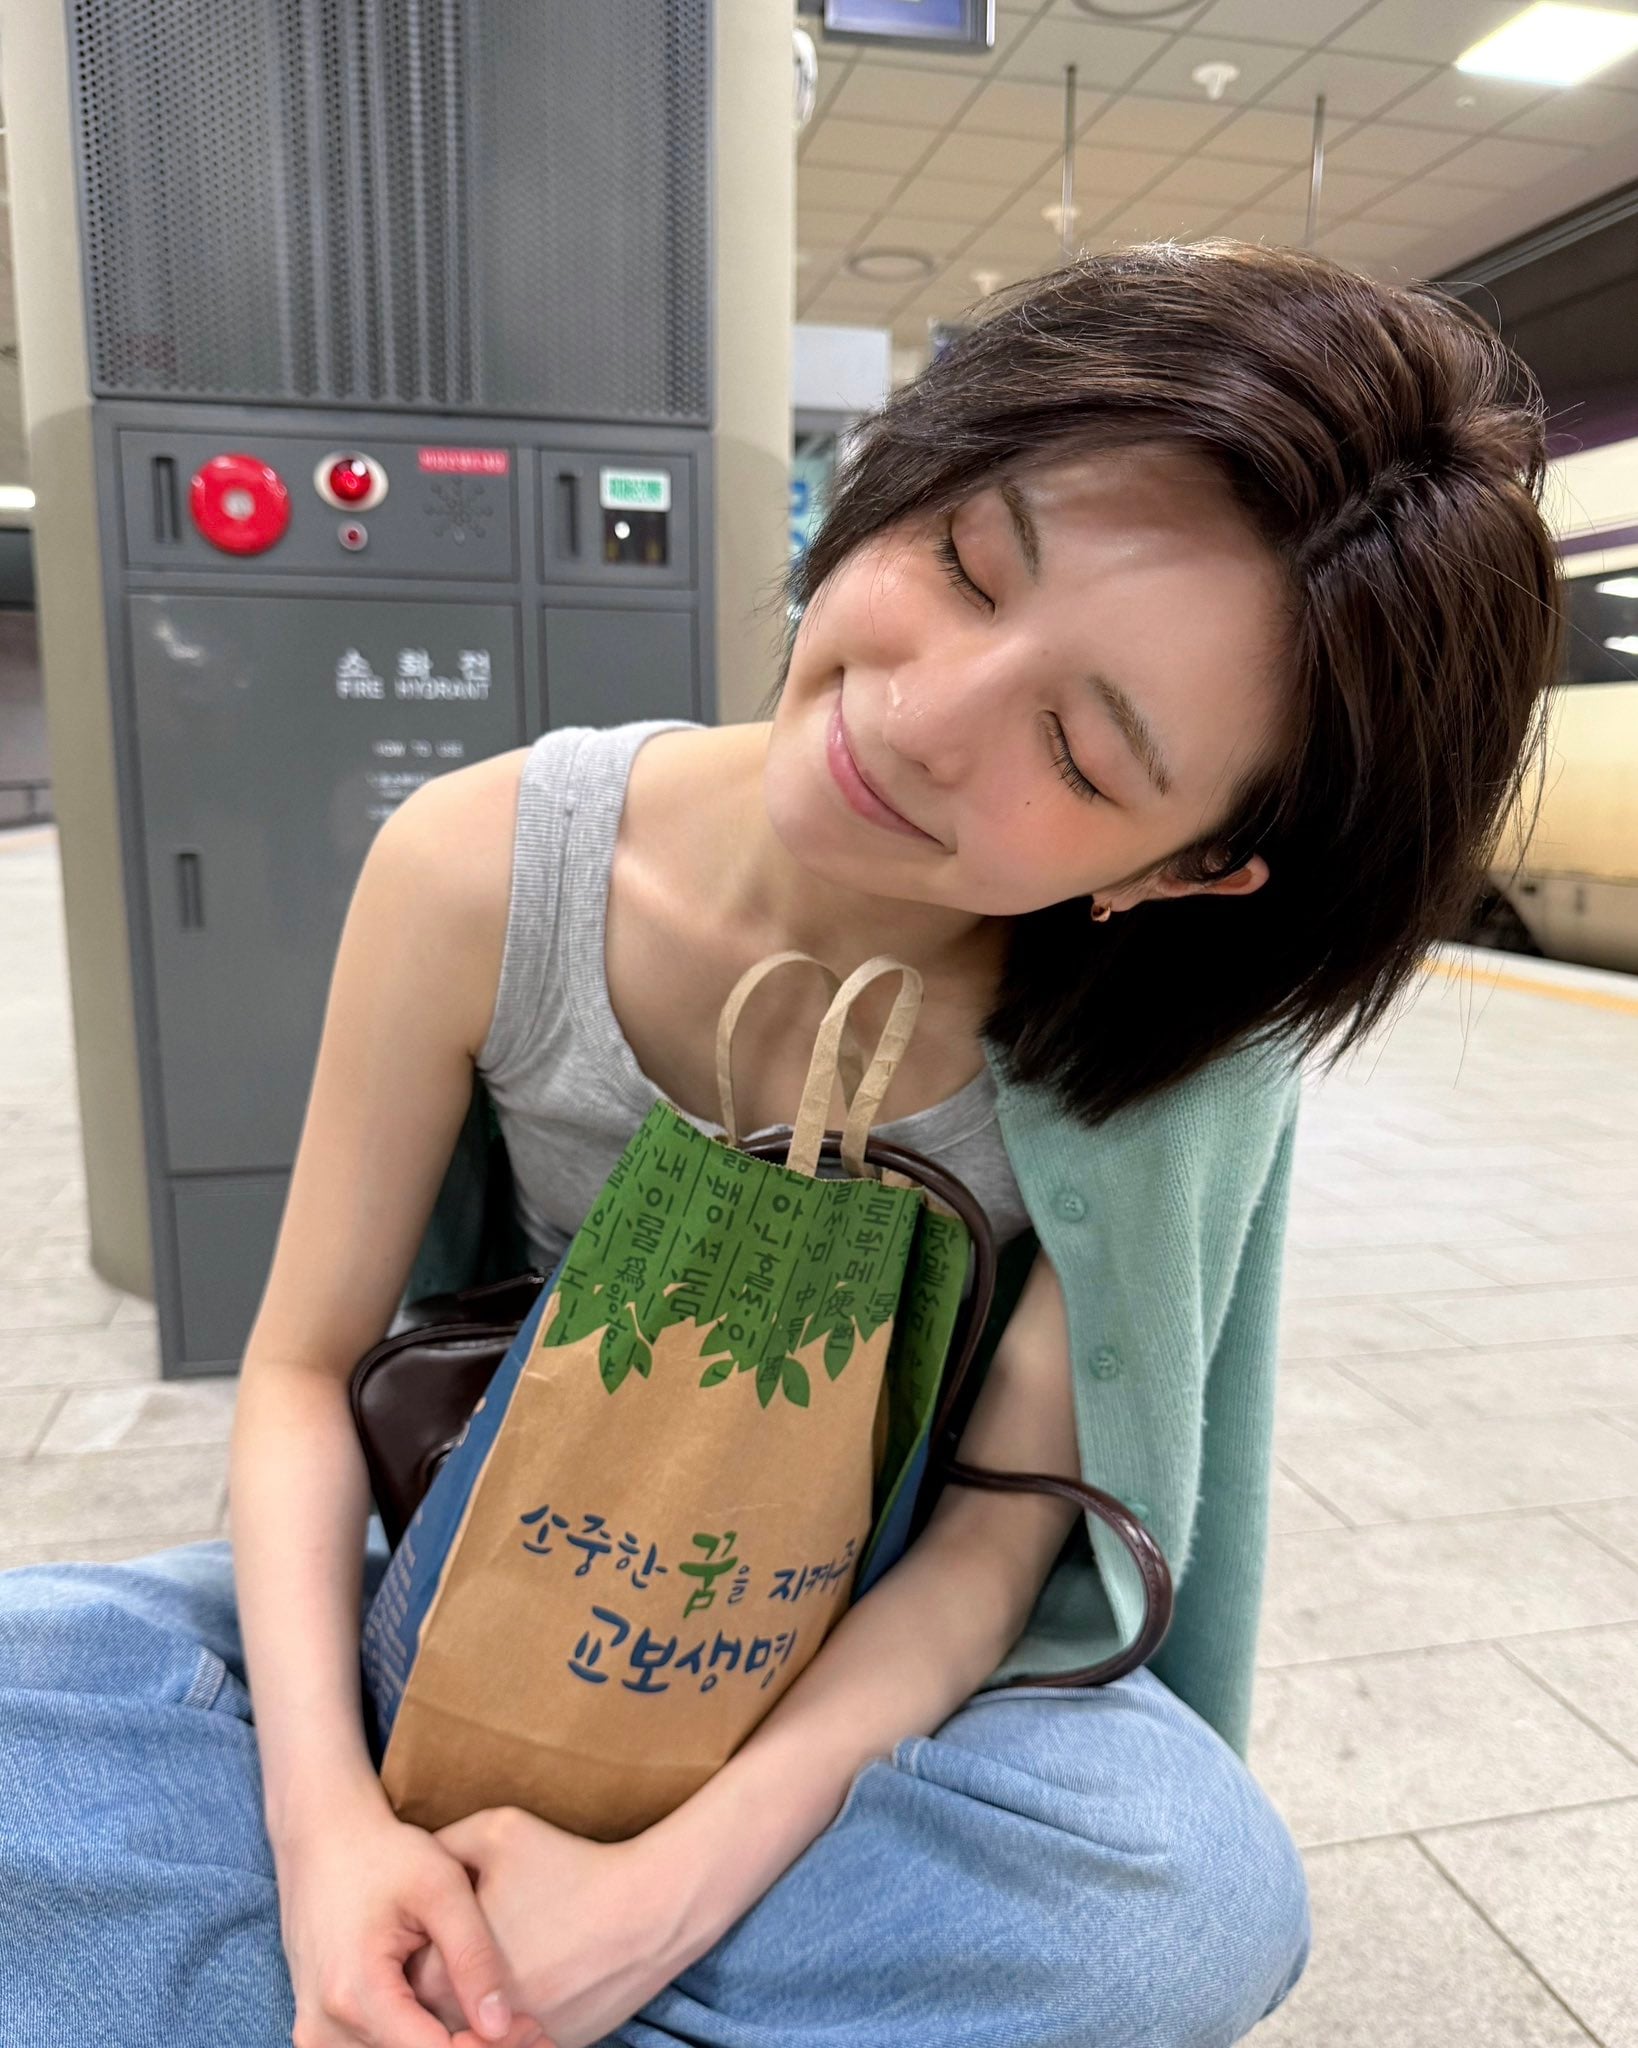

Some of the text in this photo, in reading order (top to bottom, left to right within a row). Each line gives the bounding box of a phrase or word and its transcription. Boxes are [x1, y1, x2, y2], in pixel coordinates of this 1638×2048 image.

[336, 677, 490, 699] FIRE HYDRANT
[520, 1504, 668, 1589] 소중한
[568, 1605, 797, 1692] 교보생명
